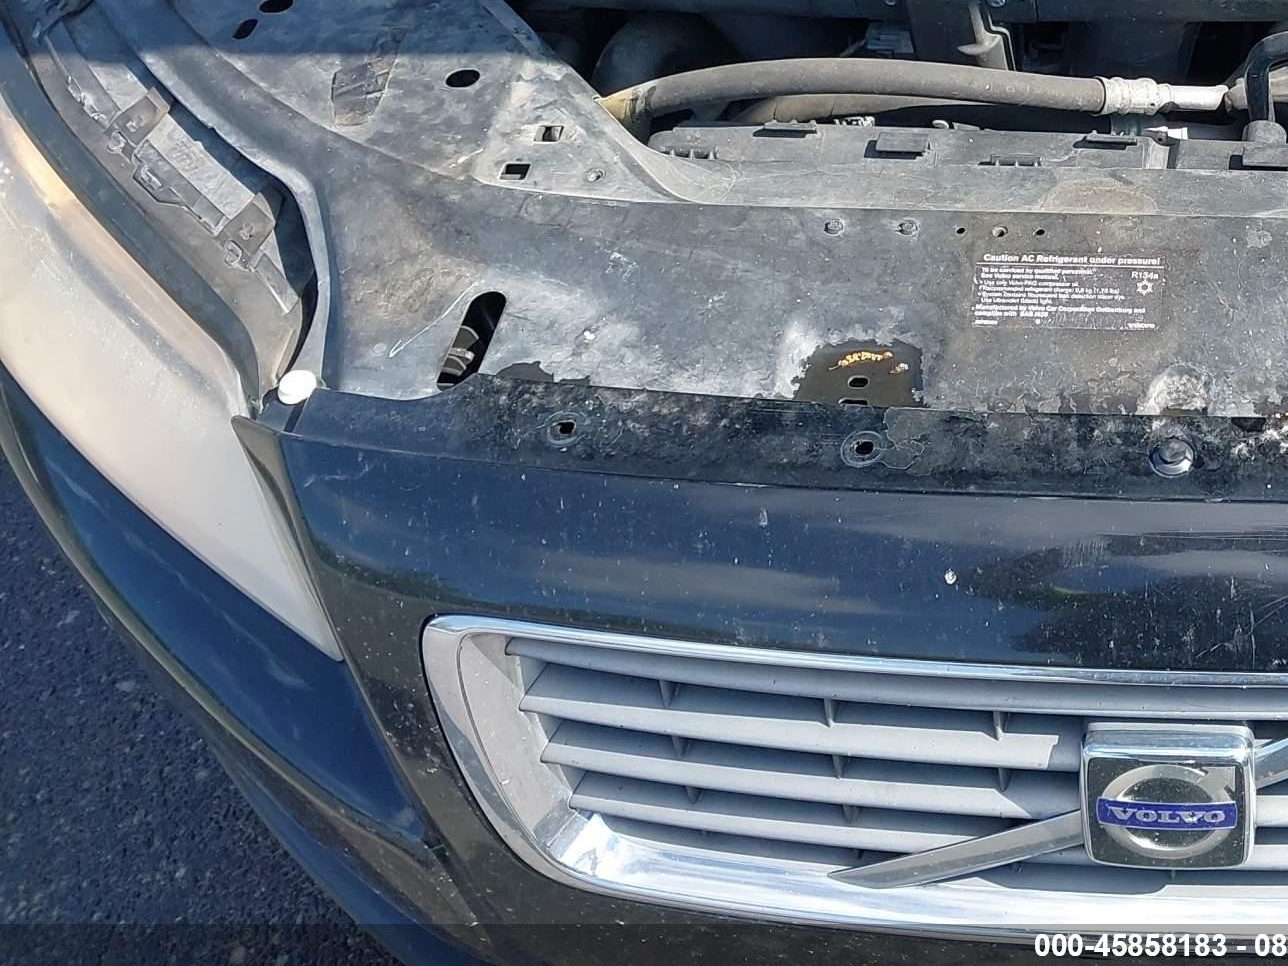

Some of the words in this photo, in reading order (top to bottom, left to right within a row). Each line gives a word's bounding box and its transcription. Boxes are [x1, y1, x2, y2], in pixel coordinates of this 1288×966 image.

[983, 254, 1019, 262] Caution
[1036, 255, 1088, 264] Refrigerant
[1089, 256, 1116, 264] under
[1118, 258, 1160, 266] pressure!
[1131, 271, 1159, 280] R134a
[1107, 805, 1225, 824] VOLVO
